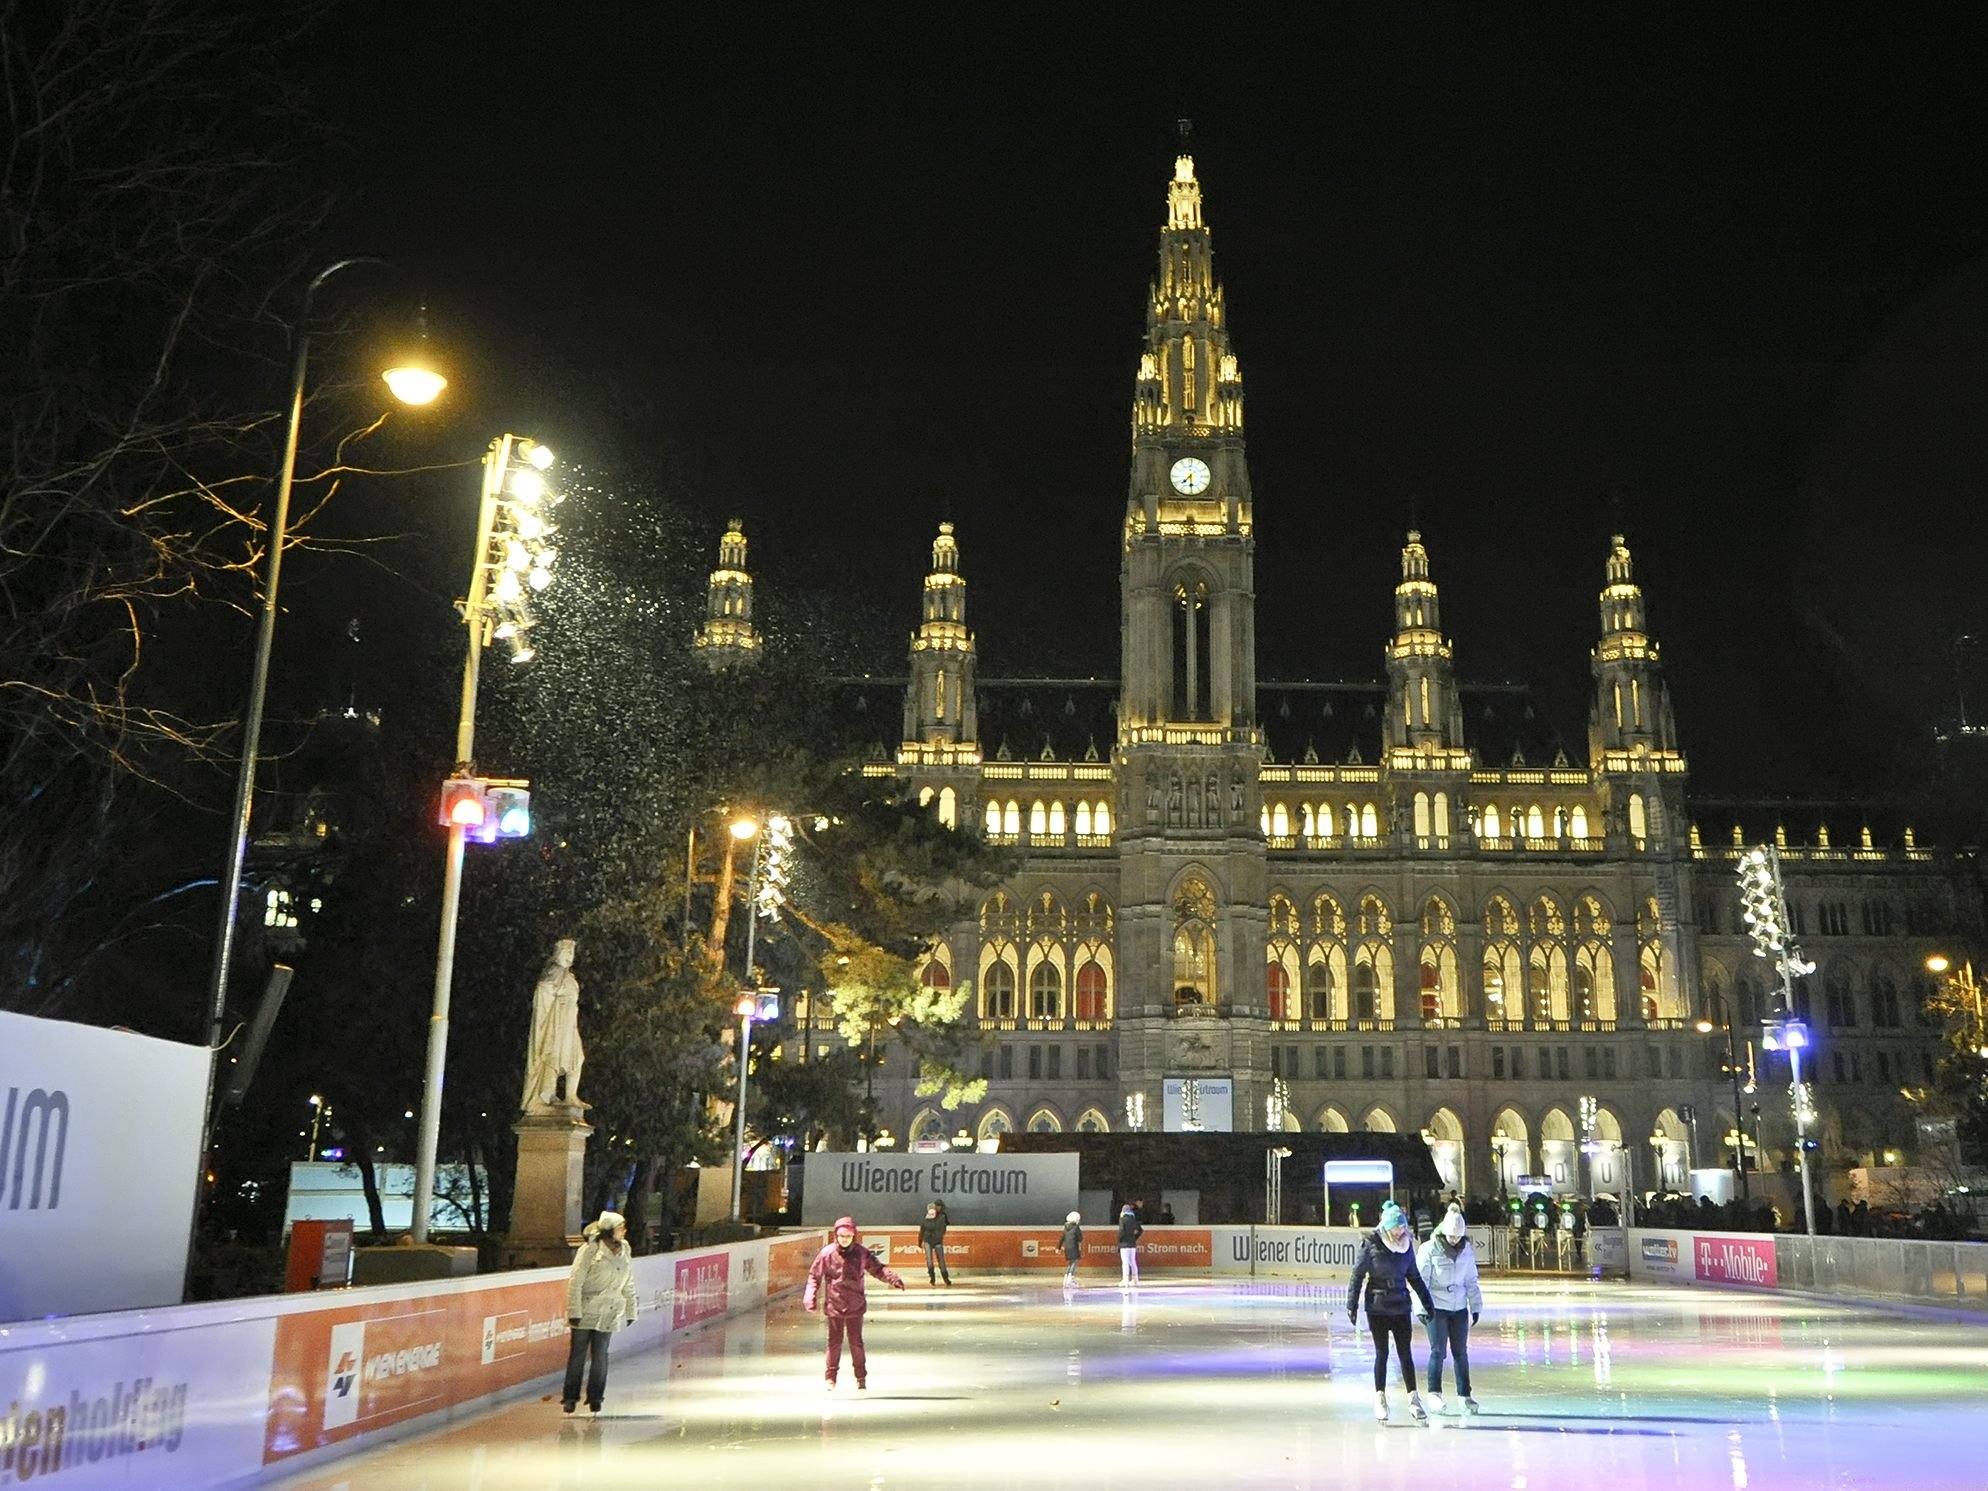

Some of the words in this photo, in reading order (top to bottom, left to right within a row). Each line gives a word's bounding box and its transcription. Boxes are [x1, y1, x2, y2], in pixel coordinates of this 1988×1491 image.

[841, 1160, 923, 1193] Wiener
[930, 1161, 1027, 1194] Eistraum
[1147, 1243, 1176, 1254] Strom
[1180, 1242, 1208, 1254] nach.
[1233, 1234, 1290, 1263] Wiener
[1295, 1236, 1355, 1266] Eistraum
